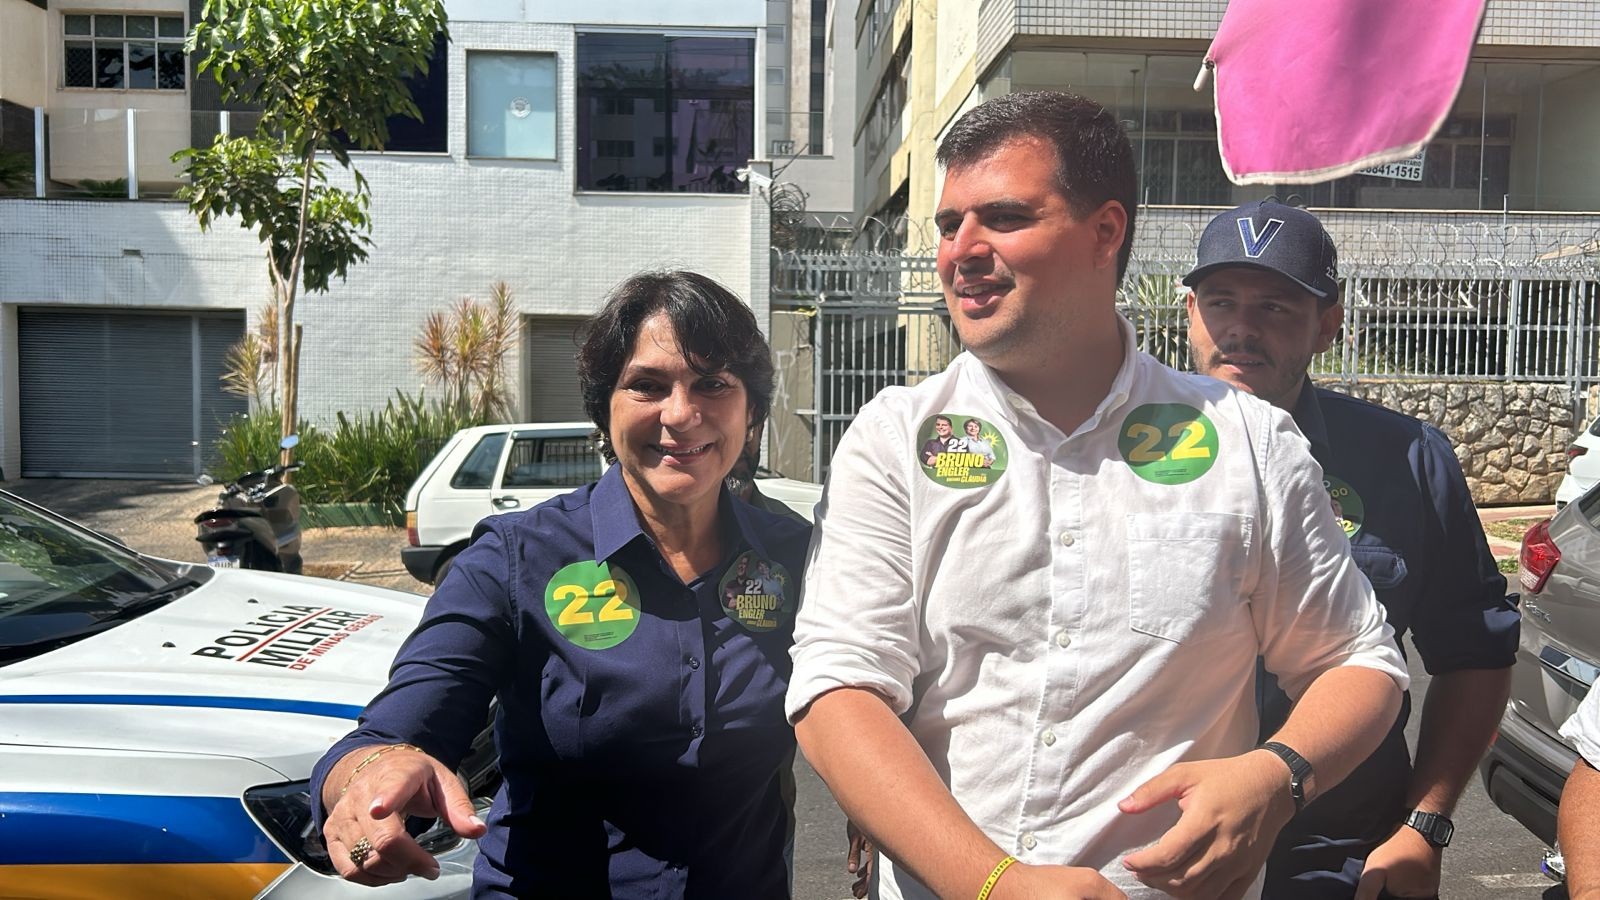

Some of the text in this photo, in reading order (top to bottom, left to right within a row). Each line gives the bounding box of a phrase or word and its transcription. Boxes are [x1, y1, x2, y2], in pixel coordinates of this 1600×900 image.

[1236, 217, 1285, 258] V
[947, 438, 968, 453] 22
[1127, 420, 1211, 463] 22
[935, 452, 985, 468] BRUNO
[936, 466, 970, 477] ENGLER
[745, 580, 763, 595] 22
[553, 580, 634, 626] 22
[735, 594, 777, 611] BRUNO
[738, 608, 766, 620] ENGLER
[247, 610, 369, 667] MILITAR
[288, 657, 316, 671] DE
[307, 632, 351, 657] MINAS
